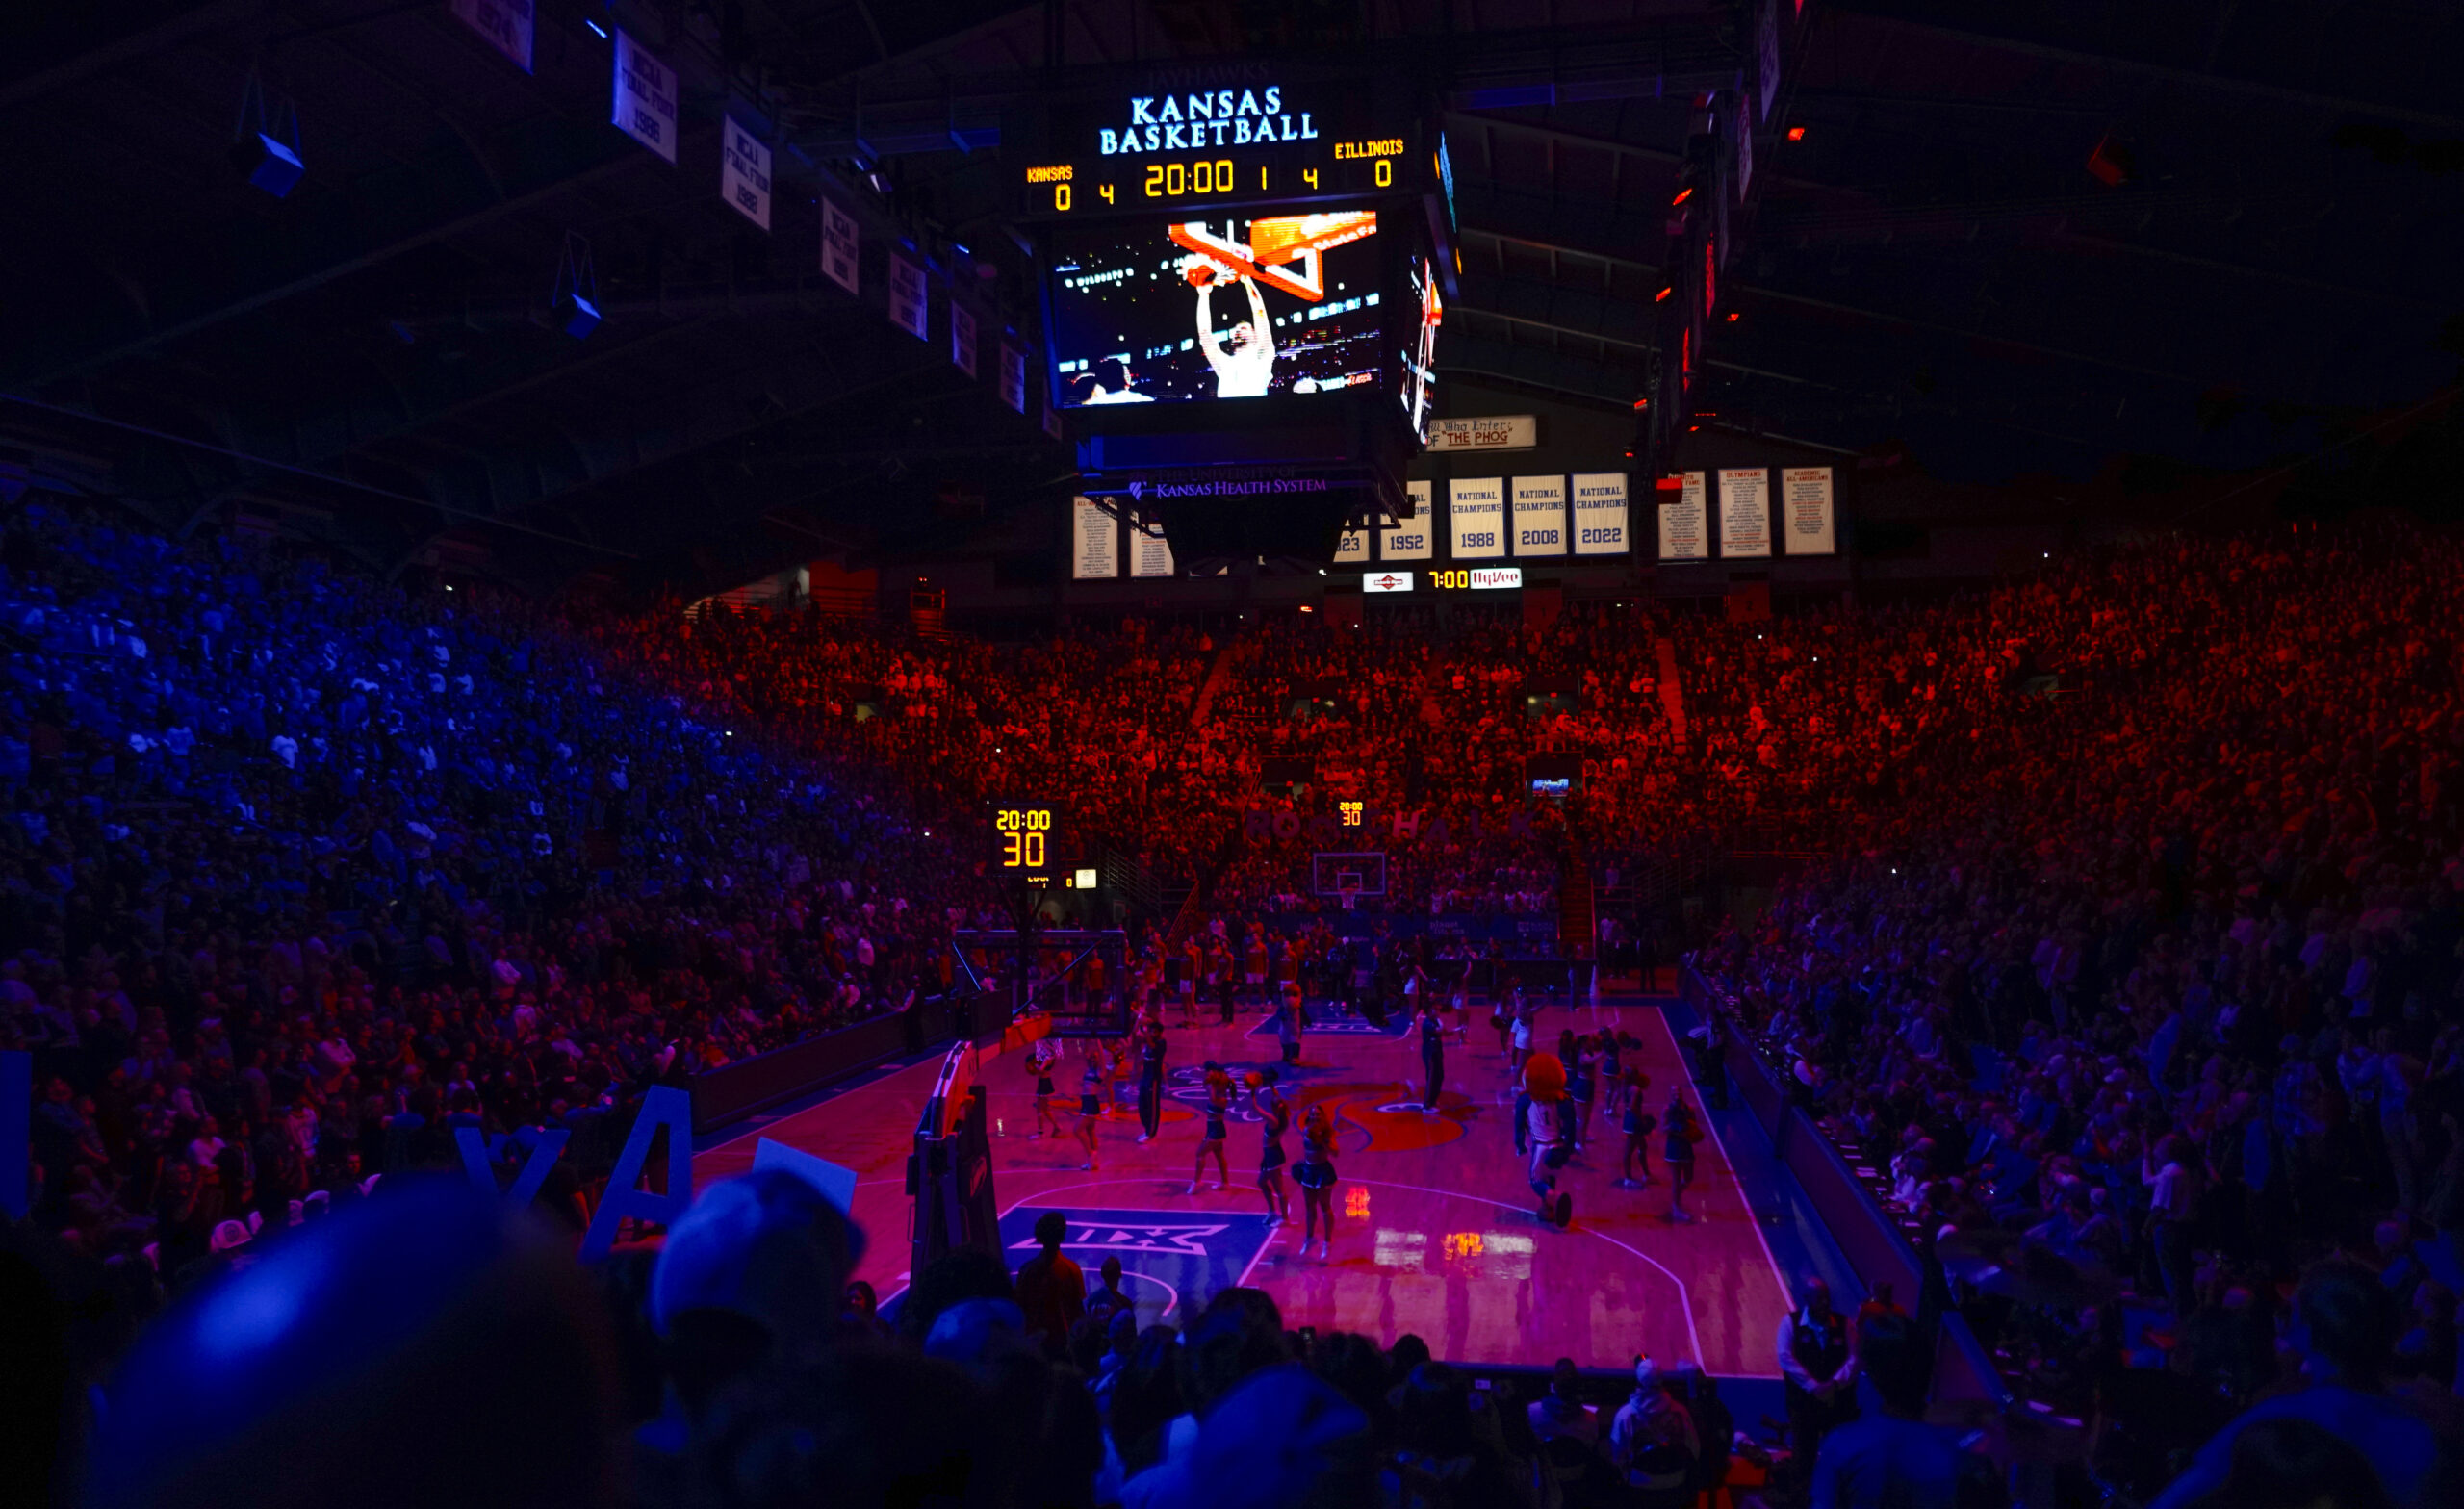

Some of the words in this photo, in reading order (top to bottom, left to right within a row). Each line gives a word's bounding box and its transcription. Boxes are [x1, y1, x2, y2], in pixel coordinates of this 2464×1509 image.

[1131, 86, 1282, 125] KANSAS
[1099, 112, 1319, 156] BASKETBALL
[1334, 139, 1404, 159] EILLINOIS
[1026, 164, 1073, 183] KANSAS
[1144, 159, 1234, 197] 20:00
[1261, 166, 1268, 191] 1
[1302, 167, 1318, 191] 4
[1374, 159, 1392, 188] 0
[1054, 183, 1071, 211] 0
[1099, 183, 1115, 205] 4
[1444, 420, 1468, 432] Who
[1156, 483, 1212, 499] KANSAS
[1214, 480, 1270, 497] HEALTH
[1273, 478, 1327, 494] SYSTEM
[1456, 491, 1498, 501] NATIONAL
[1519, 489, 1560, 499] NATIONAL
[1579, 486, 1622, 497] NATIONAL
[1452, 503, 1502, 514] CHAMPIONS
[1514, 500, 1564, 512] CHAMPIONS
[1576, 499, 1627, 510] CHAMPIONS
[1390, 535, 1424, 550] 1952
[1461, 533, 1495, 548] 1988
[1521, 530, 1559, 545] 2008
[1581, 527, 1622, 544] 2022
[1428, 570, 1469, 589] 7:00
[1340, 802, 1363, 811] 20:00
[996, 810, 1051, 830] 20:00
[1343, 810, 1361, 826] 30
[1003, 831, 1044, 867] 30
